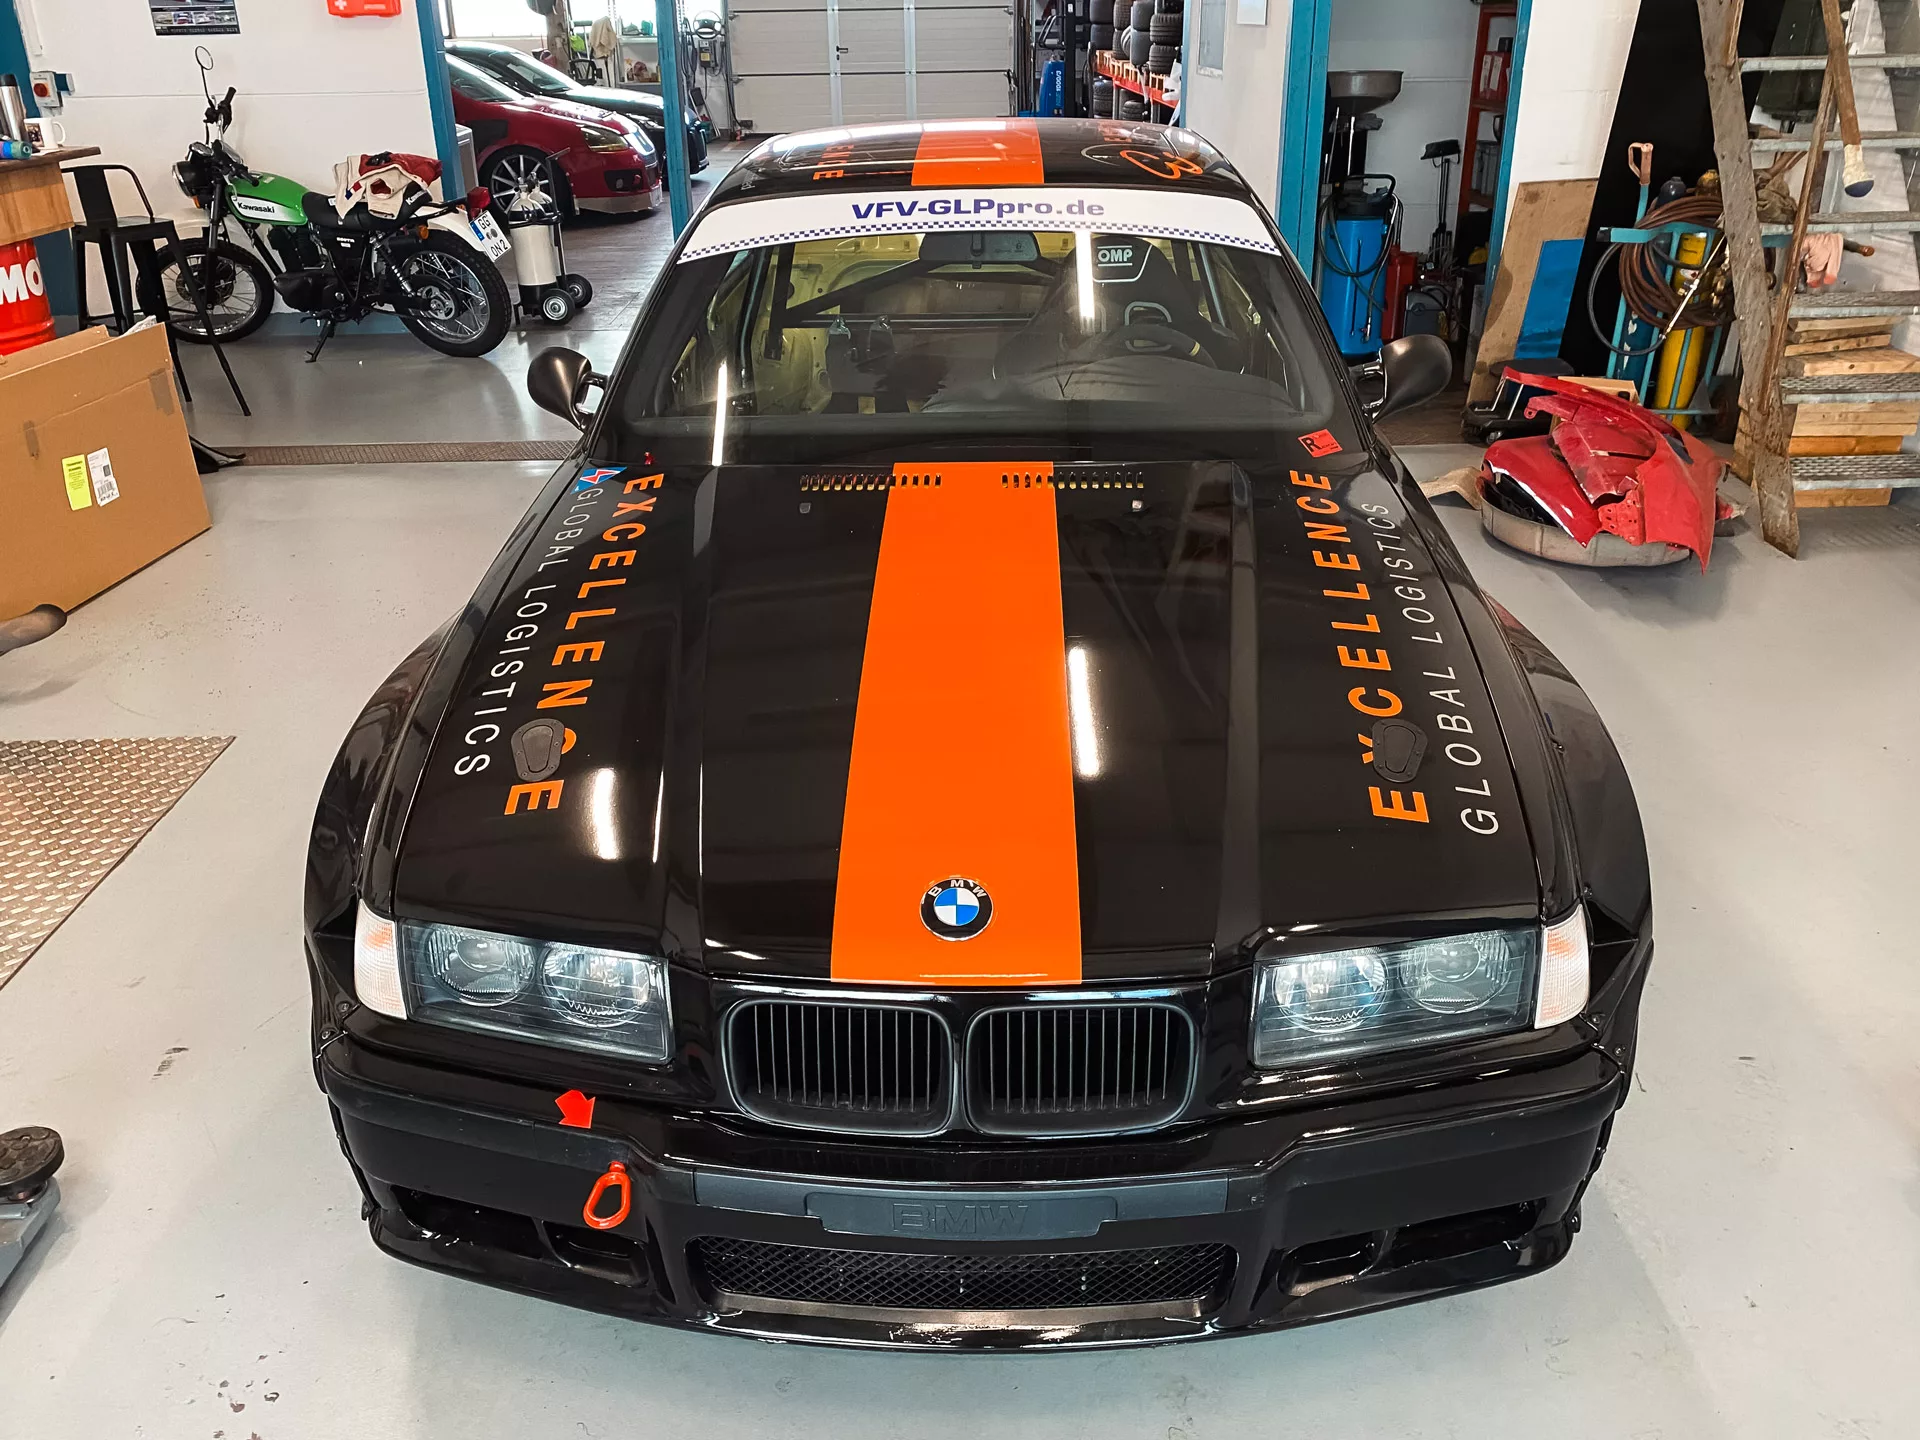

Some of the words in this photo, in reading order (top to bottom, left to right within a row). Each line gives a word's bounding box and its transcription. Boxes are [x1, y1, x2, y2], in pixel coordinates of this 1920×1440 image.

[237, 202, 276, 214] Kawasaki
[852, 199, 1105, 219] VFV-GLPpro.de
[477, 215, 491, 230] GG
[1097, 249, 1133, 262] OMP
[538, 488, 604, 573] GLOBAL
[1360, 503, 1444, 645] LOGISTICS
[453, 584, 557, 776] LOGISTICS
[1422, 667, 1499, 835] GLOBAL
[927, 879, 987, 898] BMW
[892, 1203, 1029, 1234] BMW
